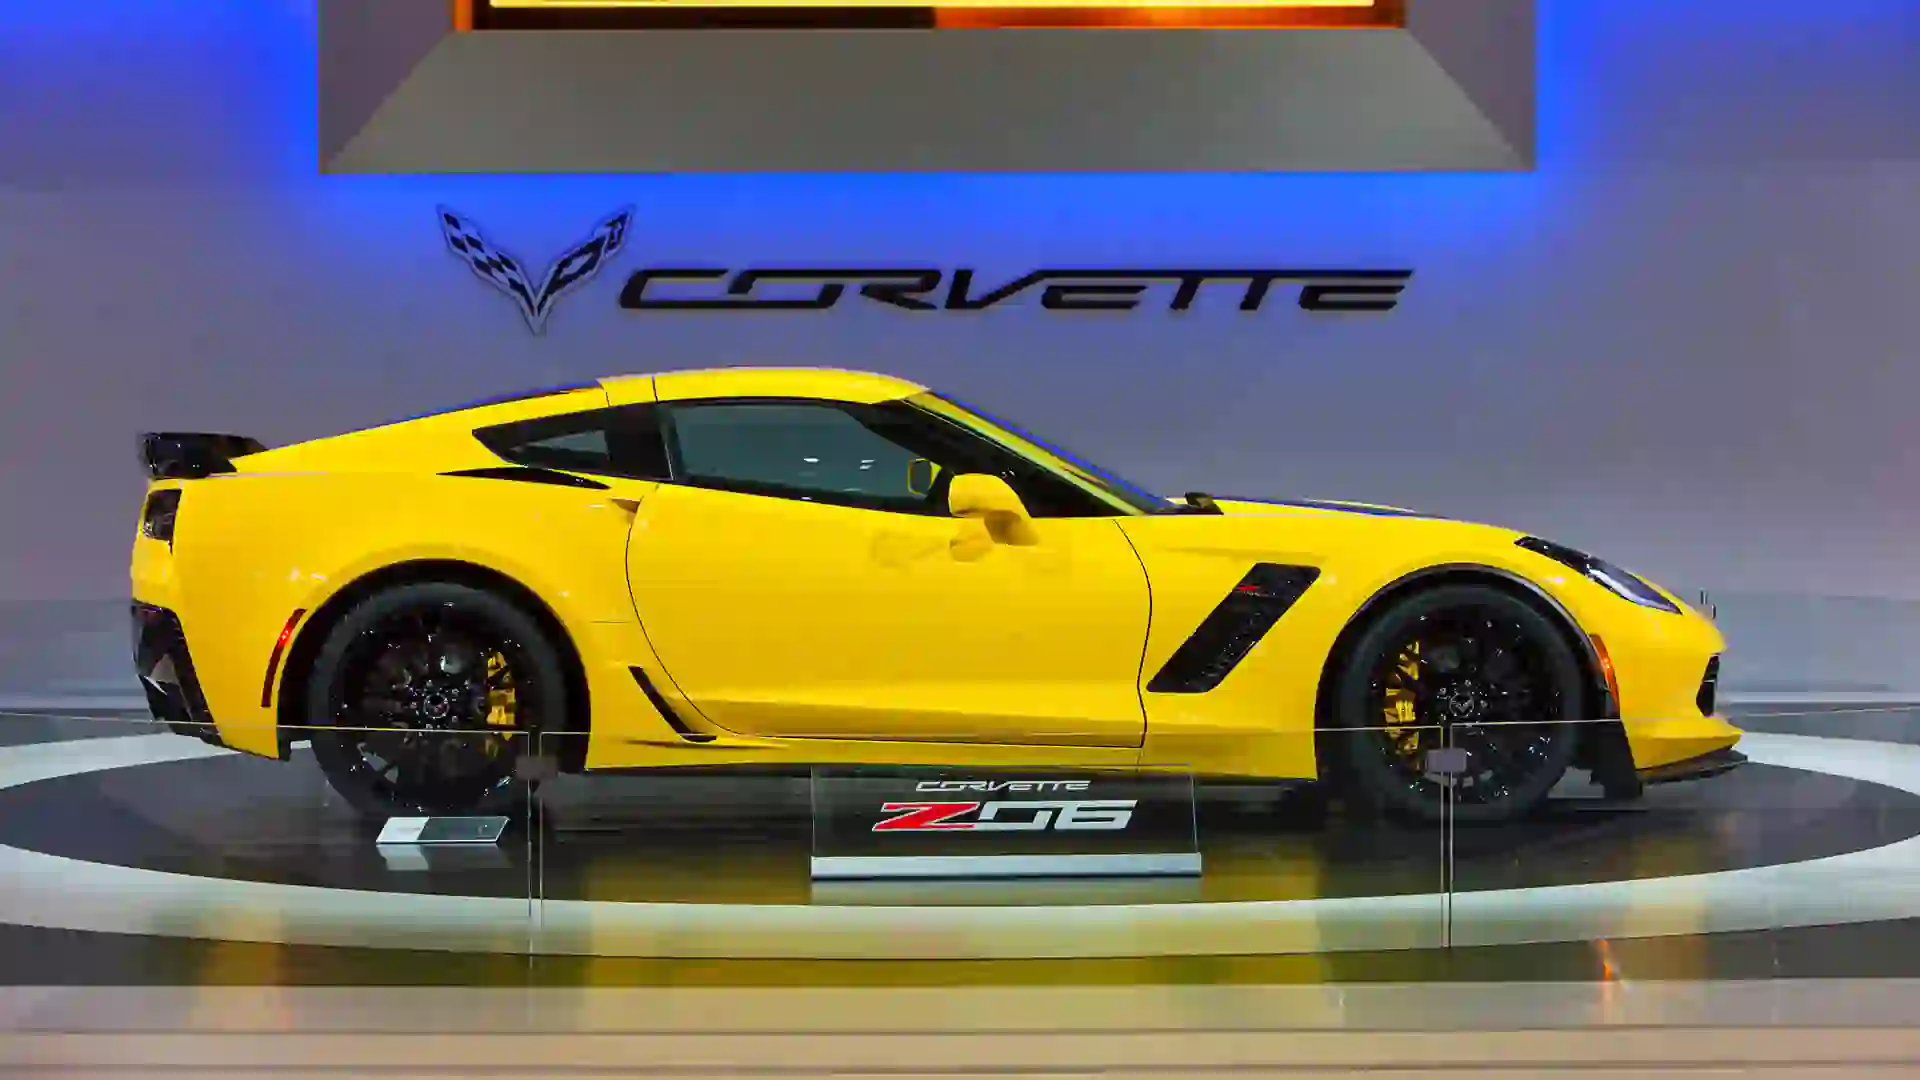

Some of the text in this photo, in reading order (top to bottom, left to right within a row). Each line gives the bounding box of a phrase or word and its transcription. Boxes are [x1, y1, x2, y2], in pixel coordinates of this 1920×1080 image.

[619, 268, 1415, 311] CORVETTE
[915, 780, 1091, 792] CORVETTE
[872, 800, 1138, 831] Z06
